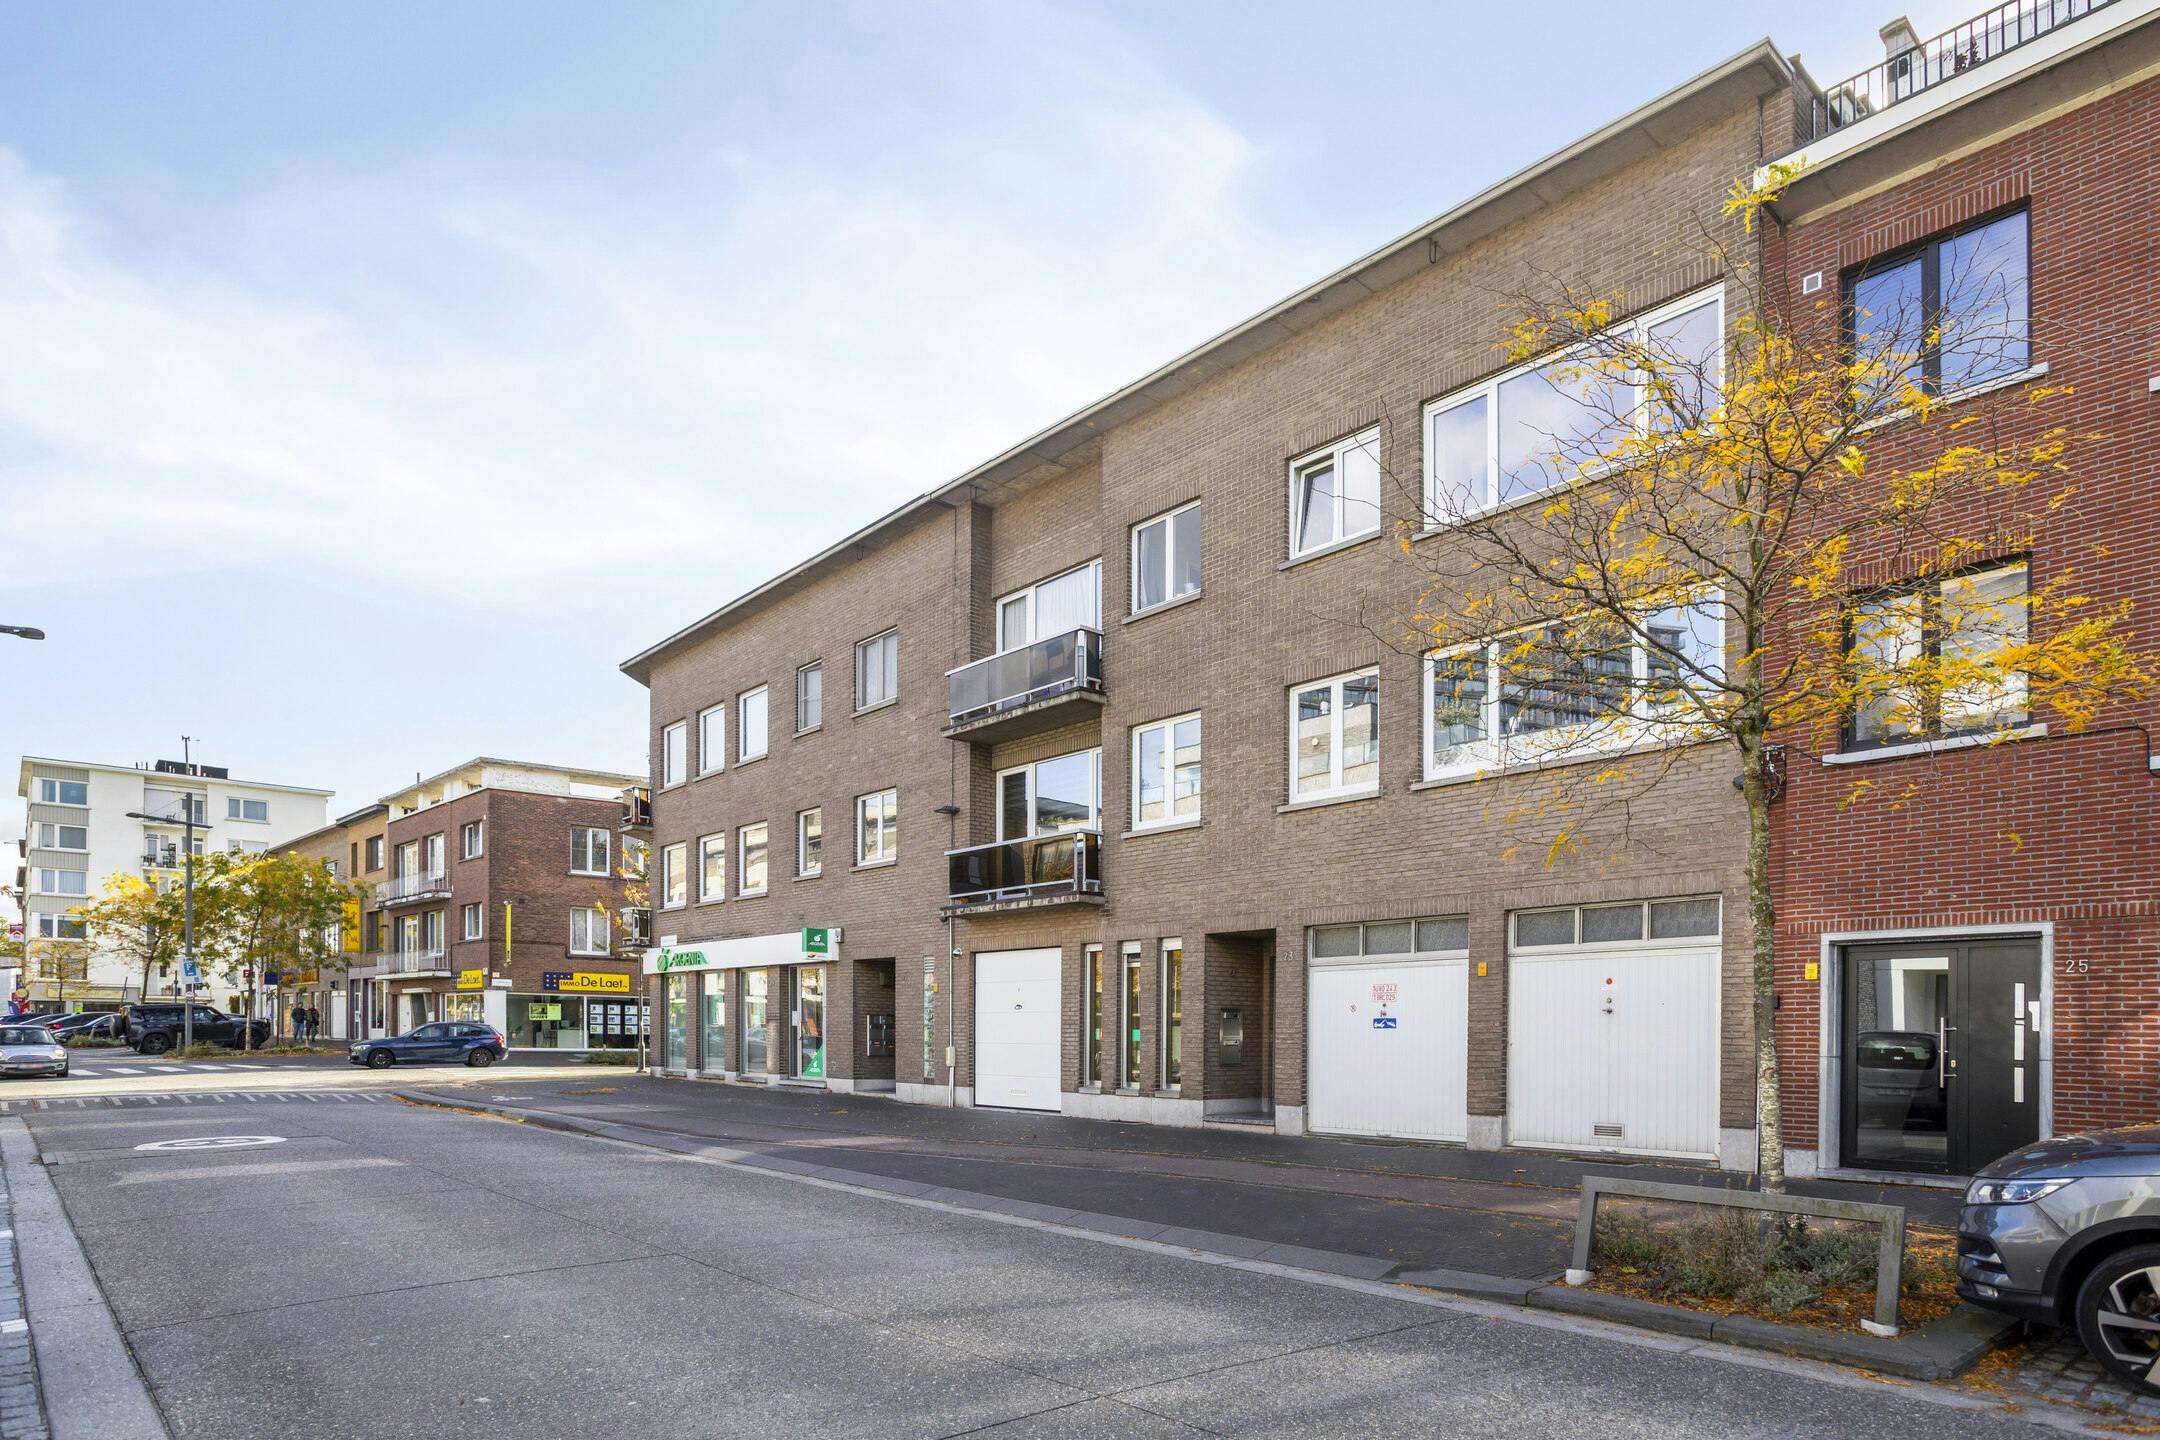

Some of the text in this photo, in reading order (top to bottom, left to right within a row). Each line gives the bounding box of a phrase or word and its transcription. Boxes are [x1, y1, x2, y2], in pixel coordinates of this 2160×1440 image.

[669, 951, 708, 967] ARGENTA
[2065, 959, 2089, 973] 25
[581, 976, 598, 987] De
[599, 977, 623, 988] Laet
